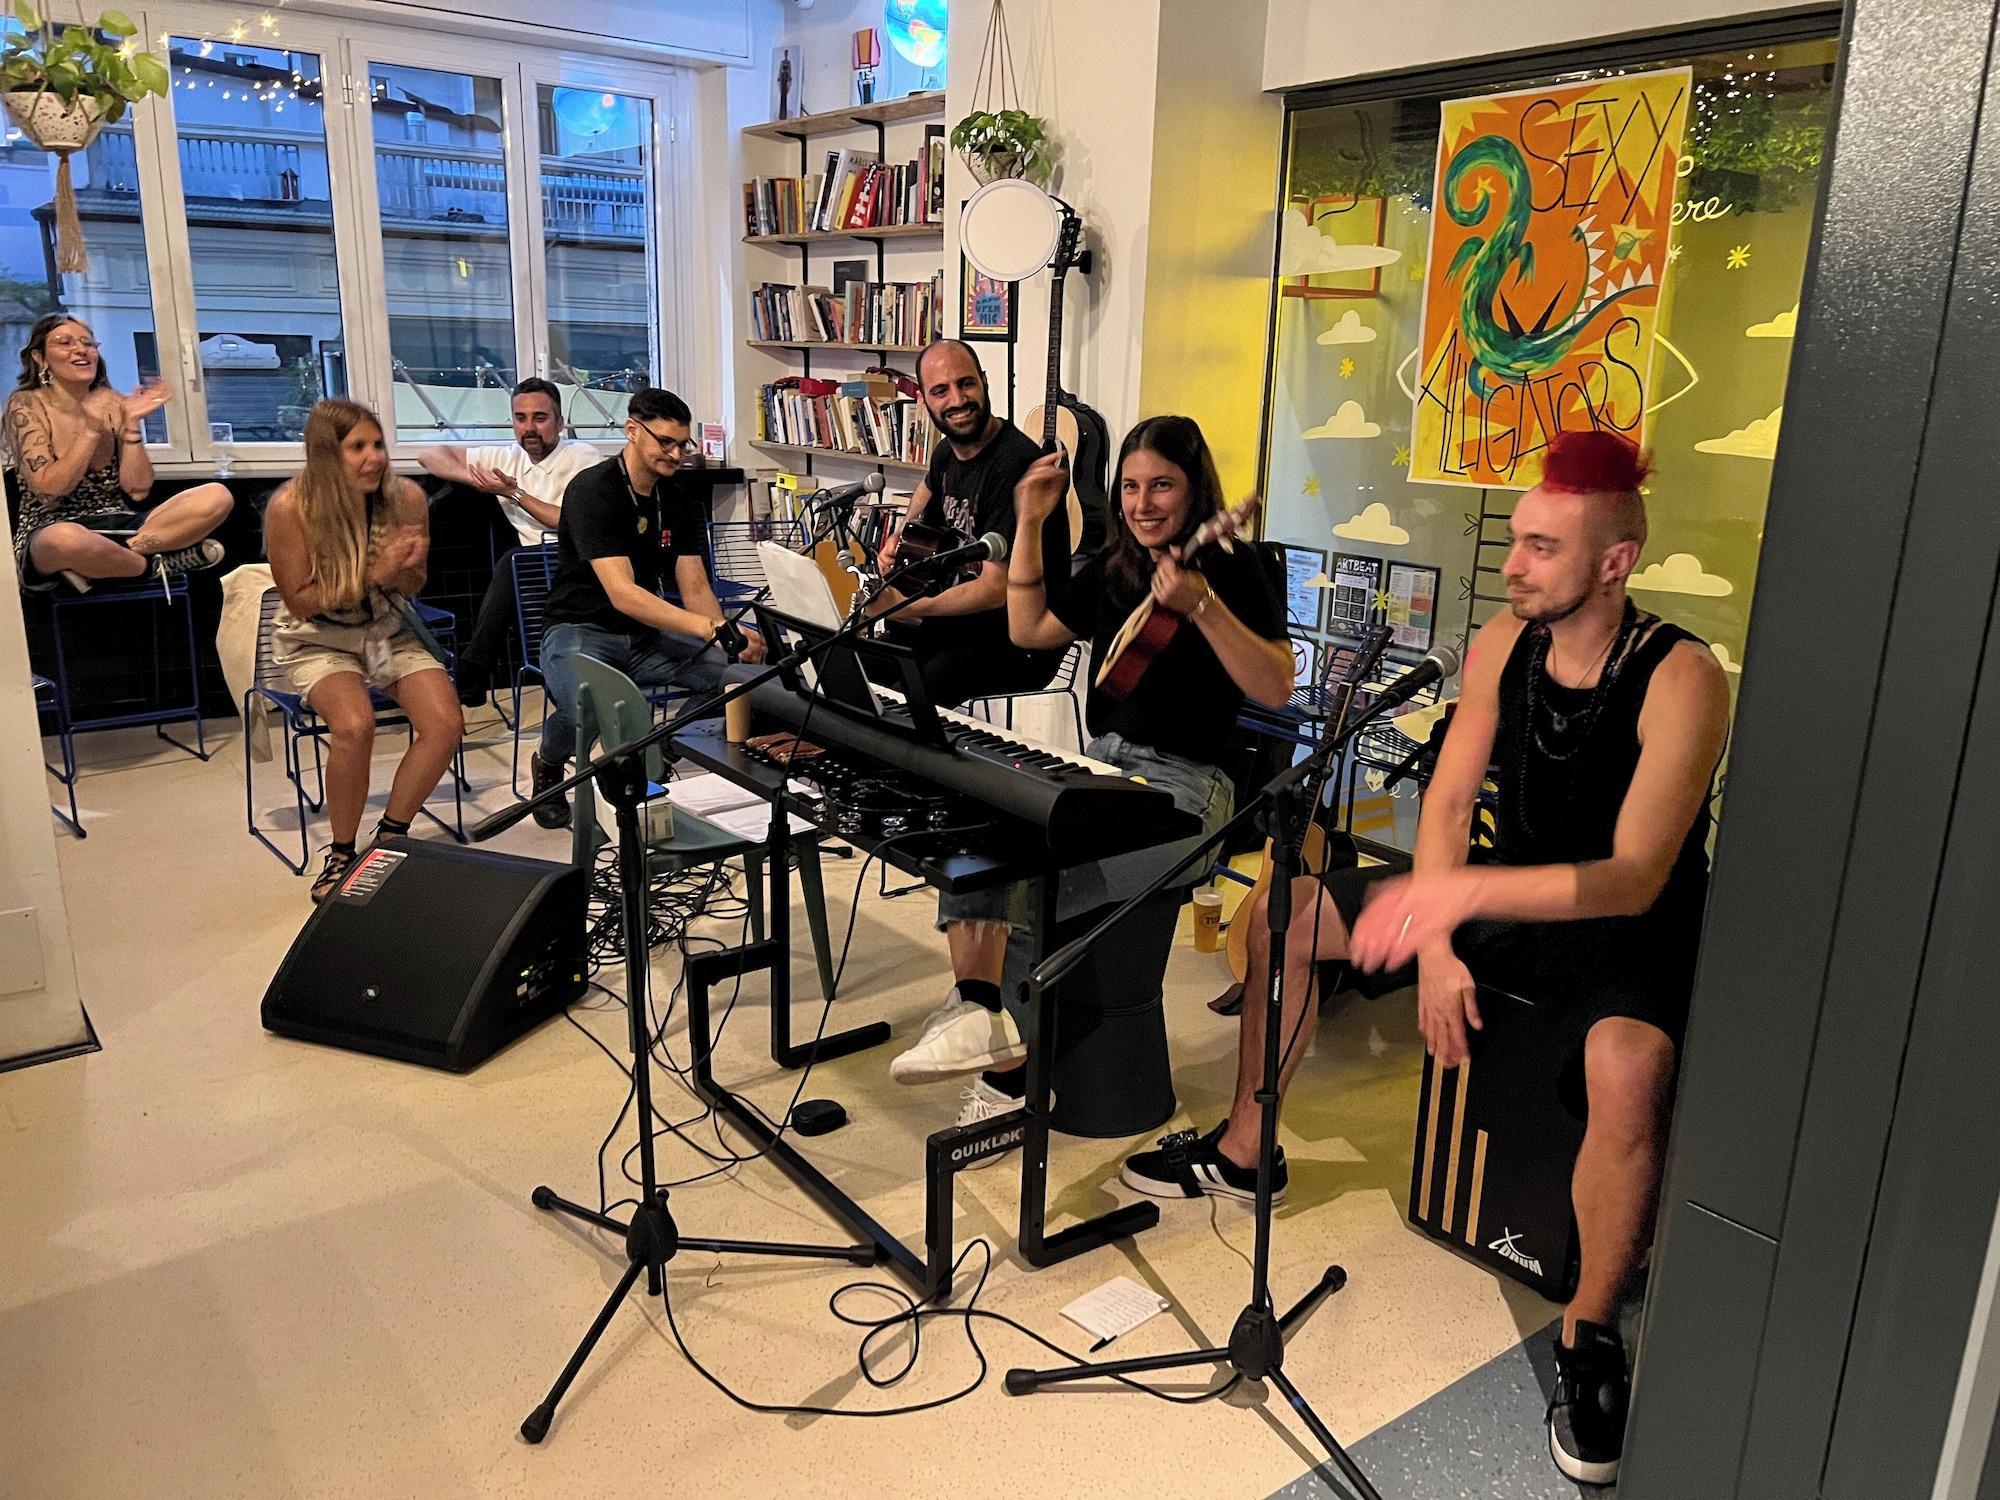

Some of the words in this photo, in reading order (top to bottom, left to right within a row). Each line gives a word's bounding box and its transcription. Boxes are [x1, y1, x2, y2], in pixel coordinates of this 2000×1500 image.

[1519, 87, 1684, 224] SEXY
[1671, 196, 1734, 226] ere
[979, 312, 998, 325] MIC
[1417, 316, 1644, 482] ALLIGATORS
[1336, 557, 1379, 574] ARTBEAT
[951, 1128, 1021, 1161] QUIKLOK
